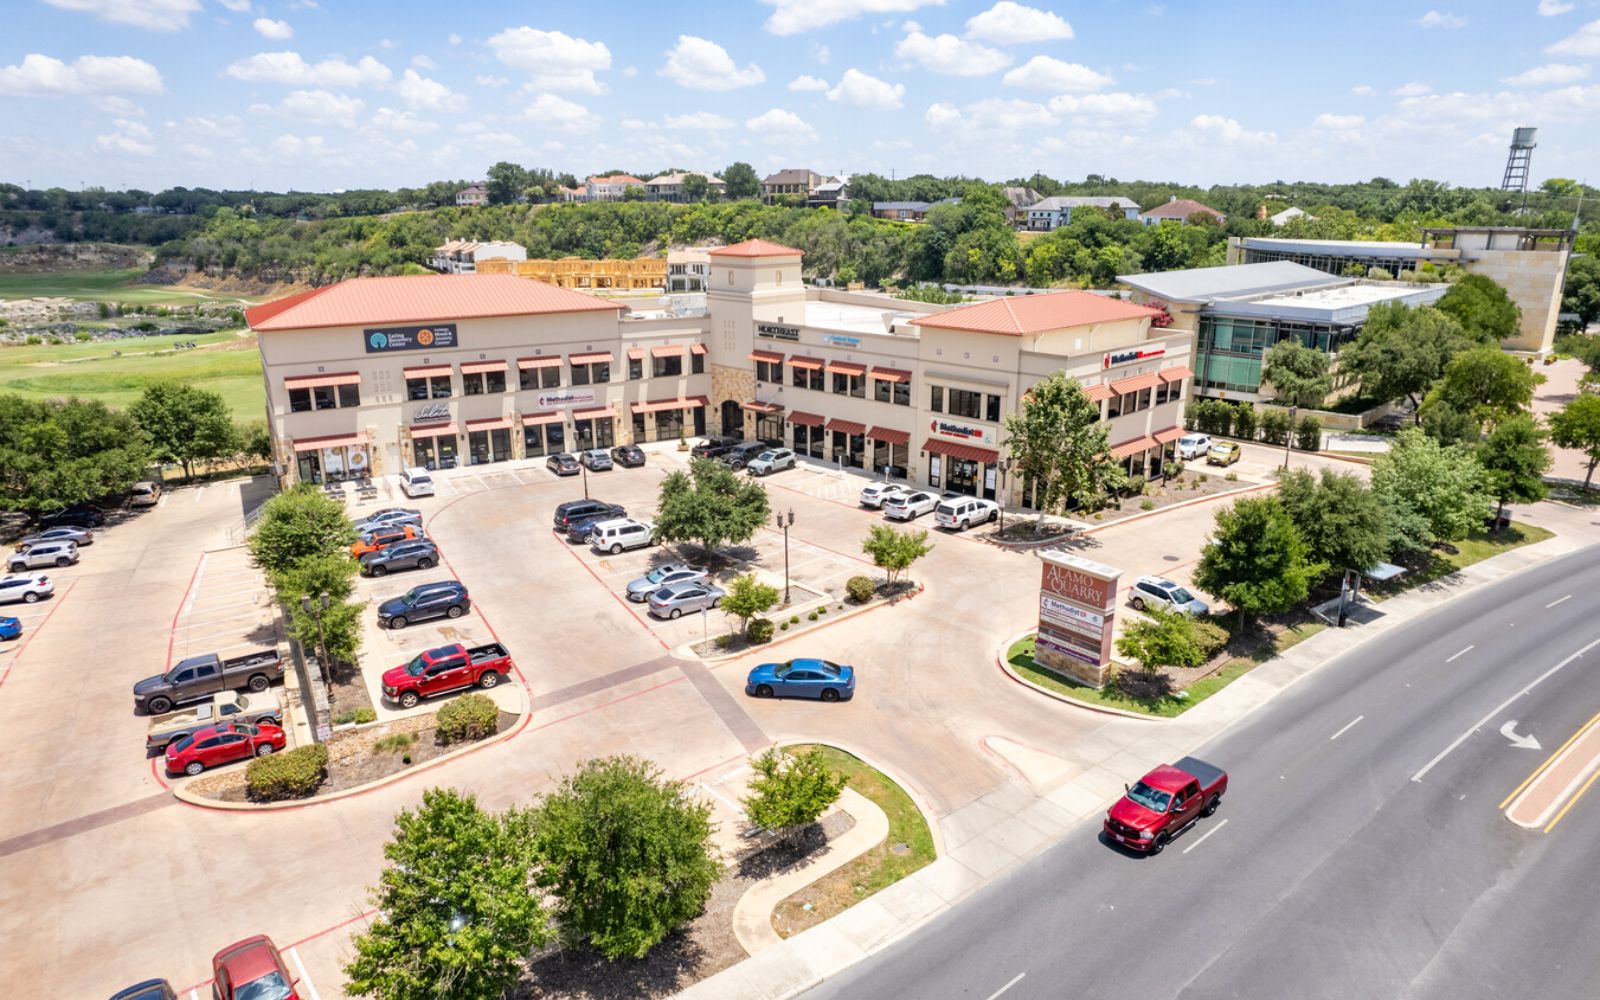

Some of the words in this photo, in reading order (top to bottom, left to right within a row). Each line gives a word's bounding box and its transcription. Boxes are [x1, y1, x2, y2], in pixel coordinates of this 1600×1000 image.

[758, 325, 799, 336] NORTHEAST
[940, 422, 975, 436] Methodist
[1046, 565, 1093, 587] ALAMO
[1051, 577, 1103, 602] QUARRY
[1051, 601, 1080, 616] Methodist
